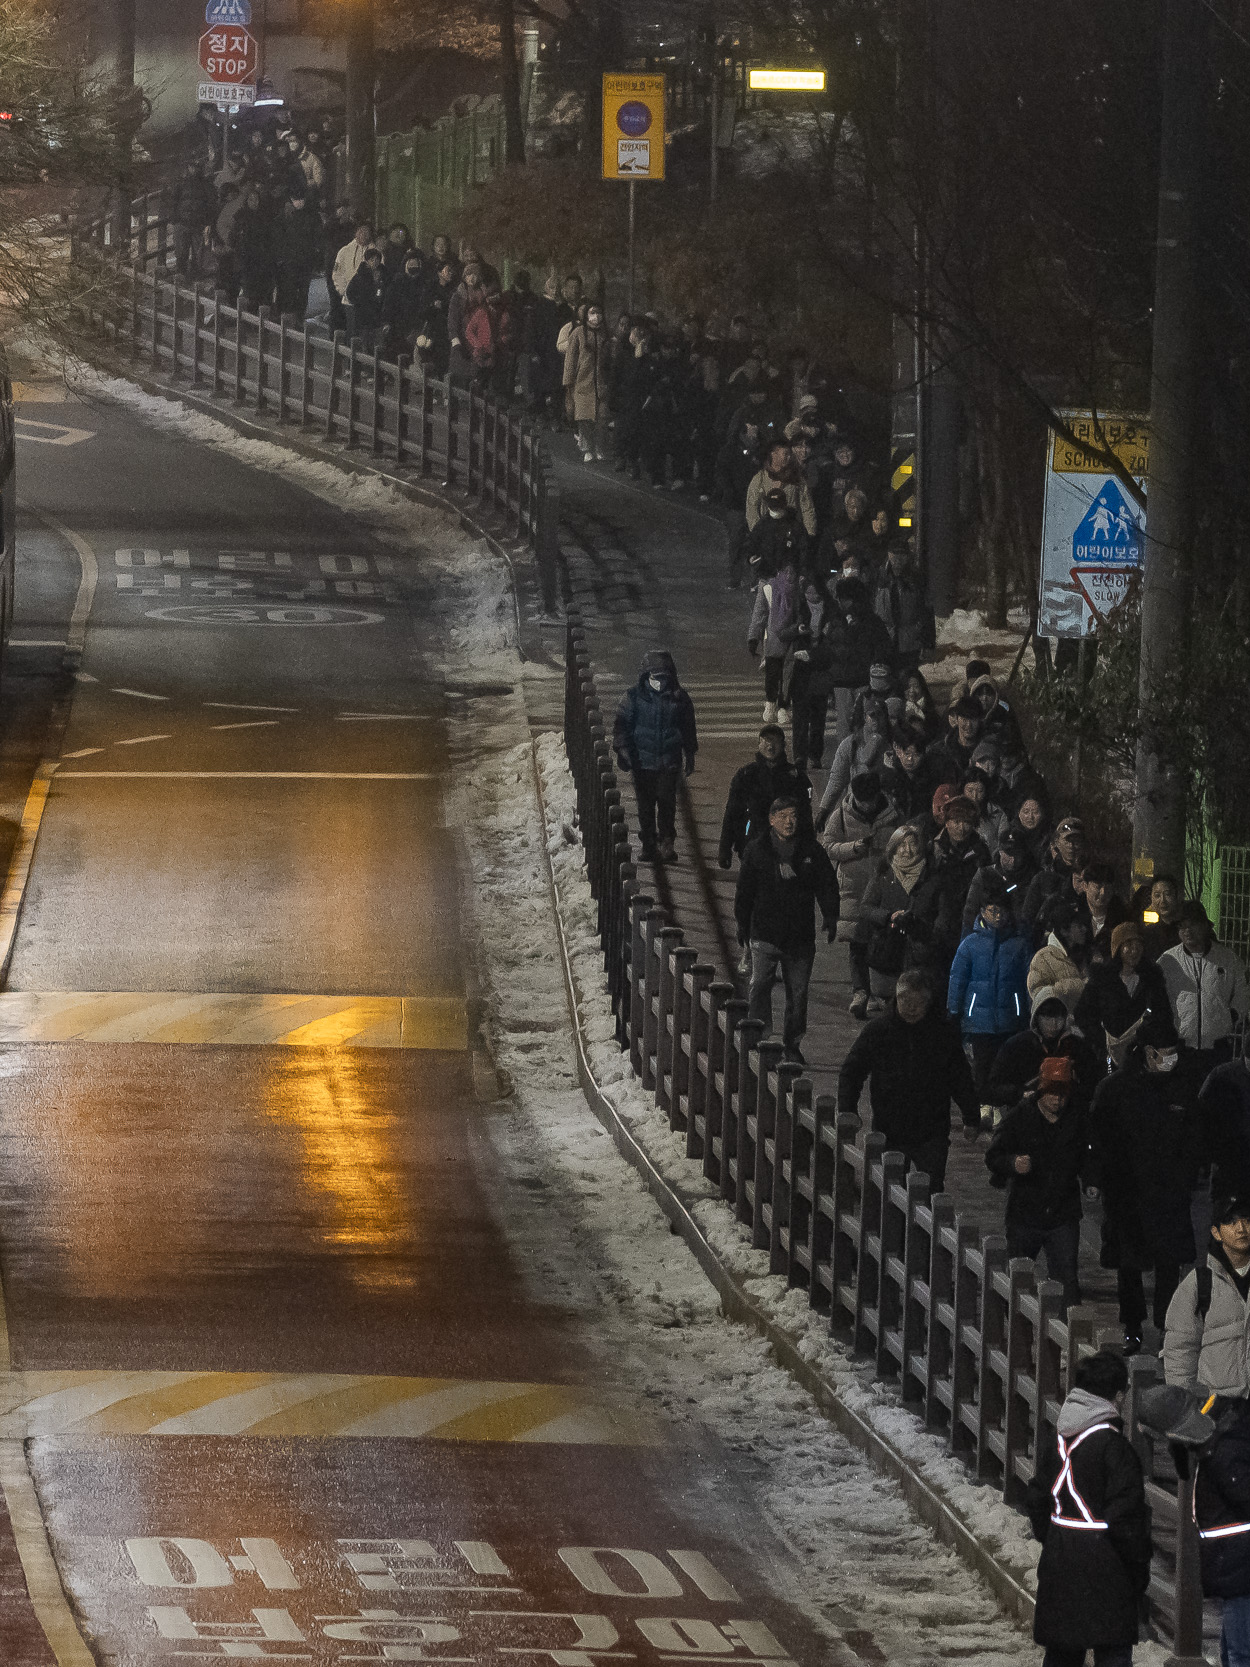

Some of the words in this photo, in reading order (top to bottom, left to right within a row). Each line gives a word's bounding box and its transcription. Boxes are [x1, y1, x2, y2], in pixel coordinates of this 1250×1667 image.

[208, 33, 248, 56] 정지
[206, 57, 247, 75] STOP
[200, 86, 253, 100] 어린이보호구역
[1076, 545, 1138, 560] 어린이보호
[114, 549, 397, 575] 어린이
[1094, 591, 1121, 602] SLOW
[192, 607, 334, 622] 30
[123, 1536, 745, 1601] 어린이
[146, 1605, 801, 1667] 보호구역
